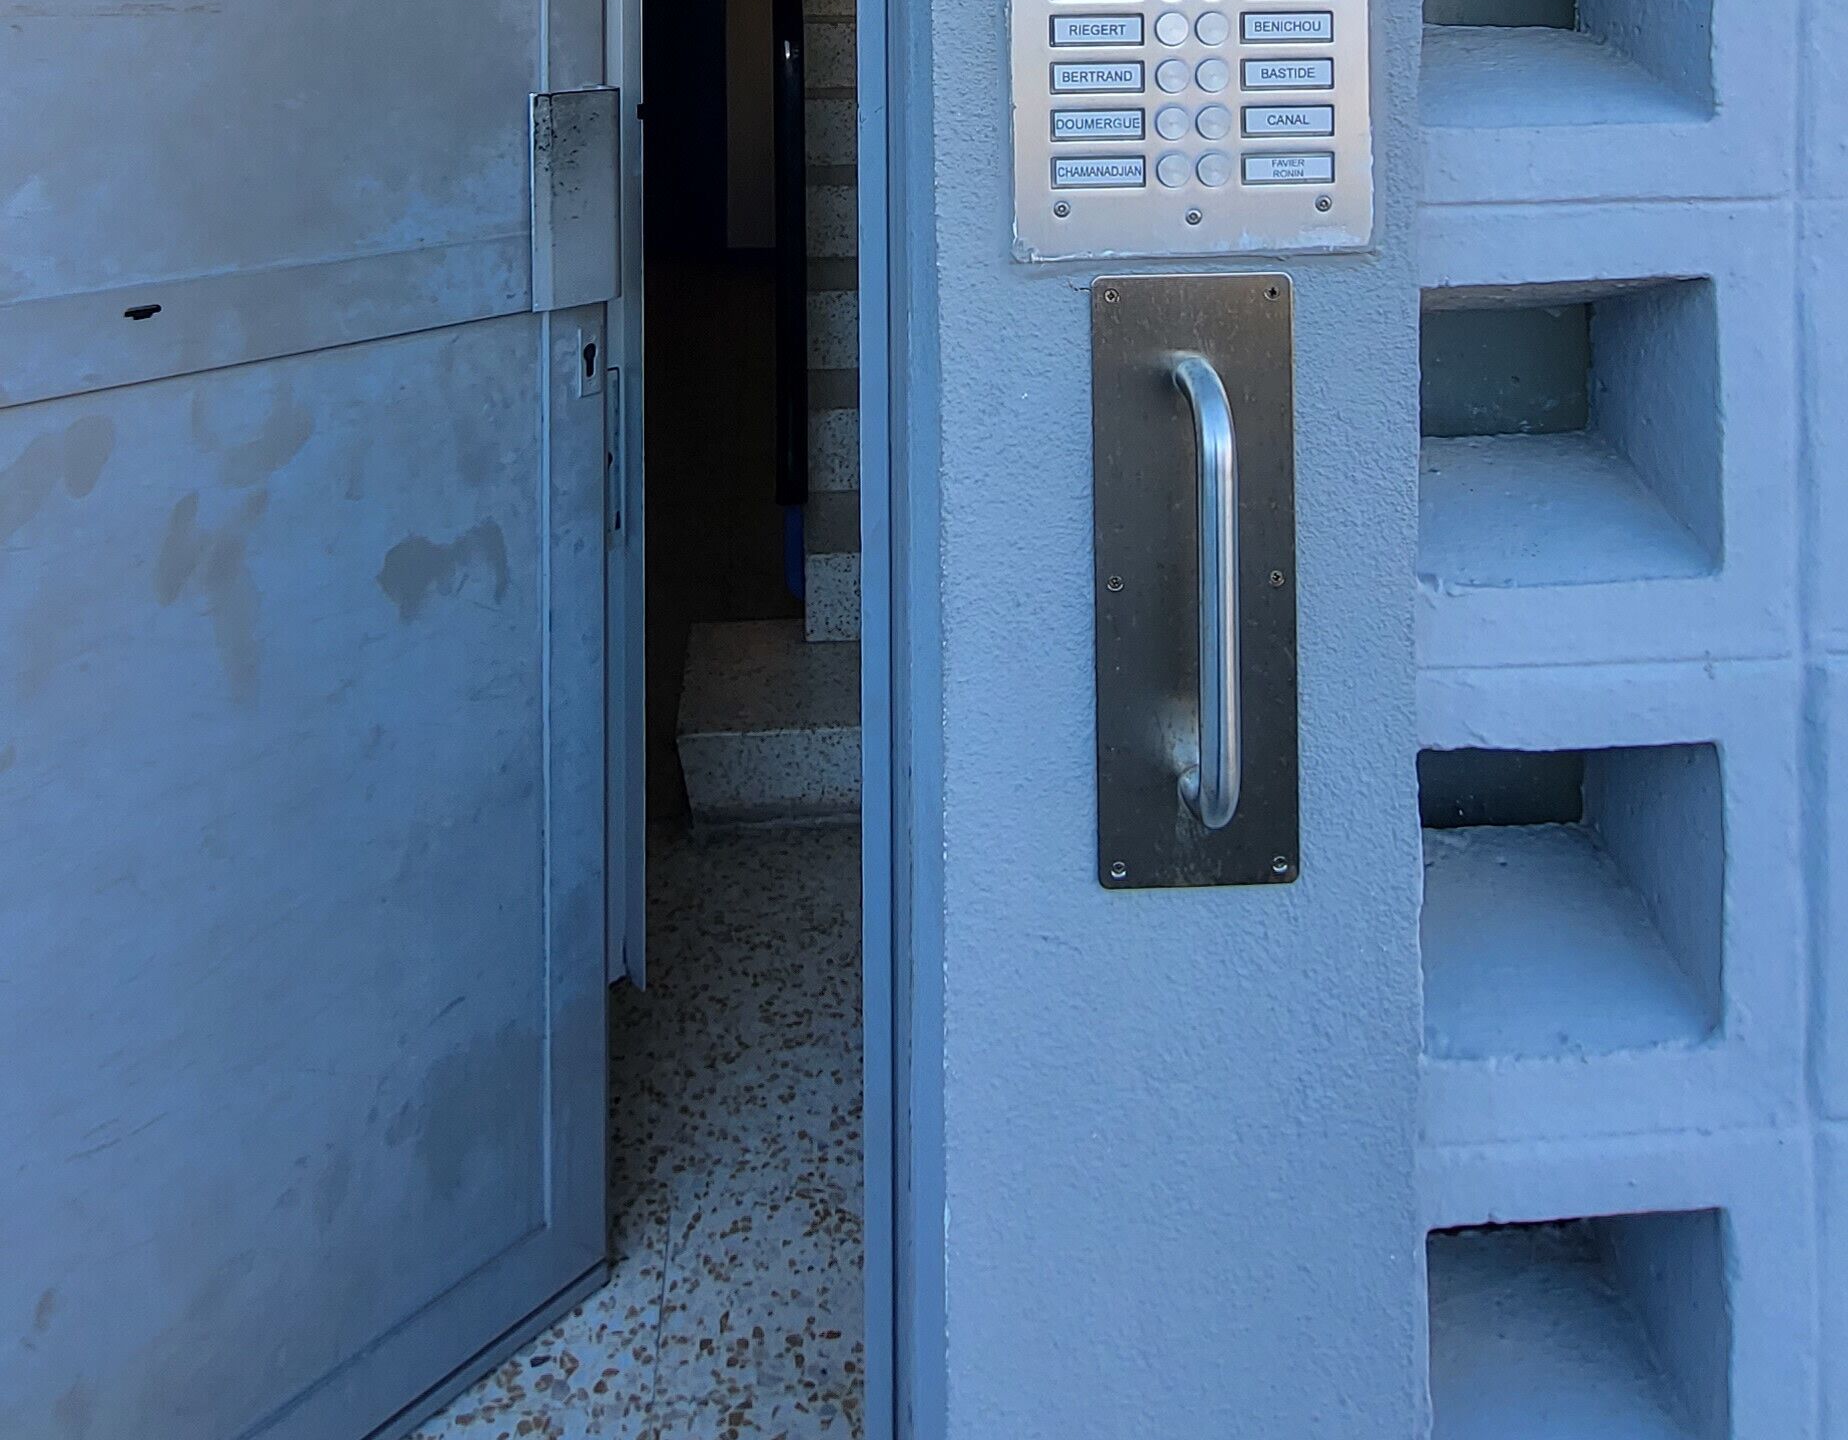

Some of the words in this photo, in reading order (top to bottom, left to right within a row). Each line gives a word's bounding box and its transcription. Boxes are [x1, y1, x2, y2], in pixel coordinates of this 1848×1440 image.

[1069, 24, 1126, 36] RIEGERT
[1254, 21, 1321, 32] BENICHOU
[1062, 70, 1133, 82] BERTRAND
[1261, 67, 1315, 79] BASTIDE
[1056, 117, 1140, 130] DOUMERGUE
[1267, 114, 1310, 126] CANAL
[1271, 159, 1305, 168] FAVIER
[1057, 165, 1142, 177] CHAMANADJIAN
[1272, 169, 1304, 178] RONIN
